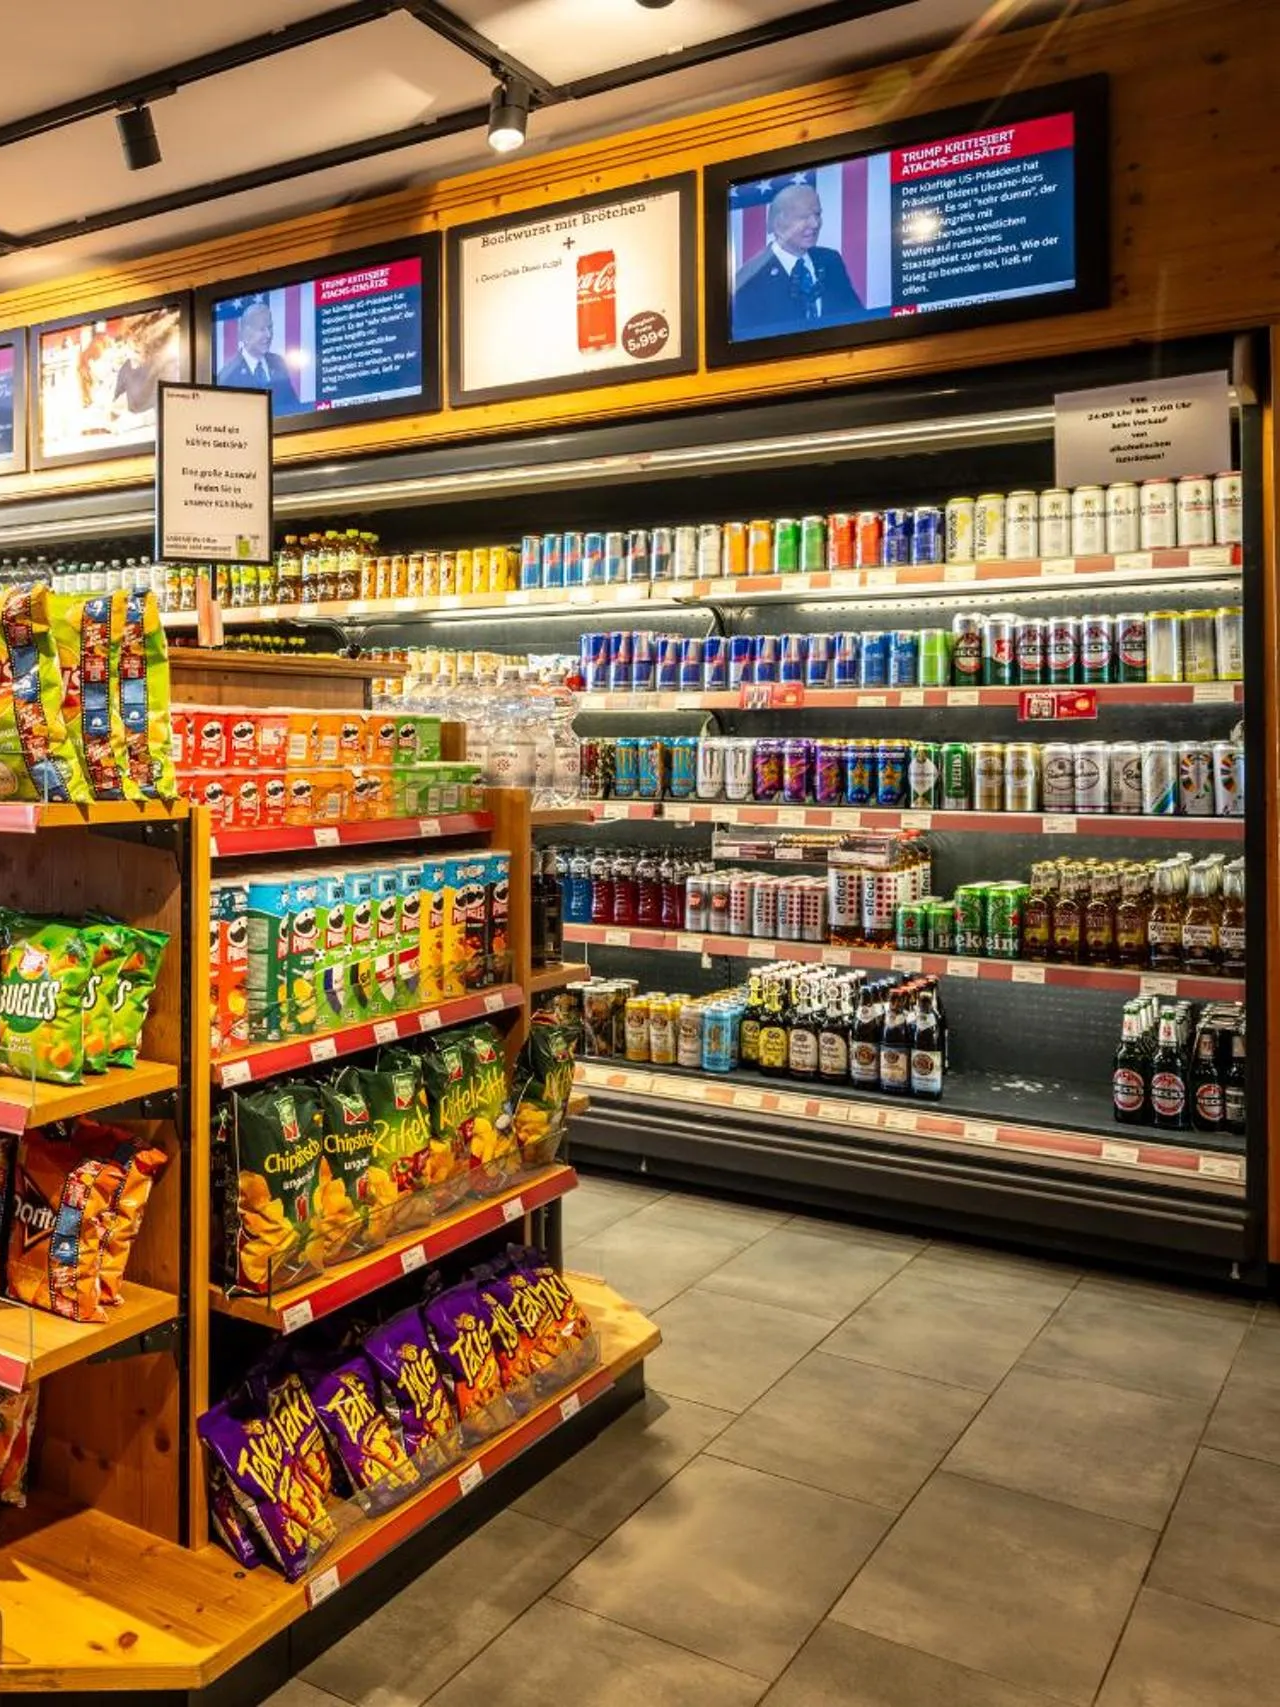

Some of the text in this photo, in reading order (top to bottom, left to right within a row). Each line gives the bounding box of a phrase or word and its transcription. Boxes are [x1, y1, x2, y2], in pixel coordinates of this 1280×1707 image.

[902, 129, 1015, 164] TRUMP KRITISIERT
[902, 185, 918, 196] Der
[1023, 160, 1040, 171] hat
[1040, 184, 1059, 195] der
[480, 203, 647, 248] Bockwurst mit Brötchen
[1041, 236, 1060, 246] der
[834, 873, 847, 915] effect
[866, 876, 875, 917] effect
[273, 1386, 316, 1455] Taki
[327, 1383, 376, 1445] Taki
